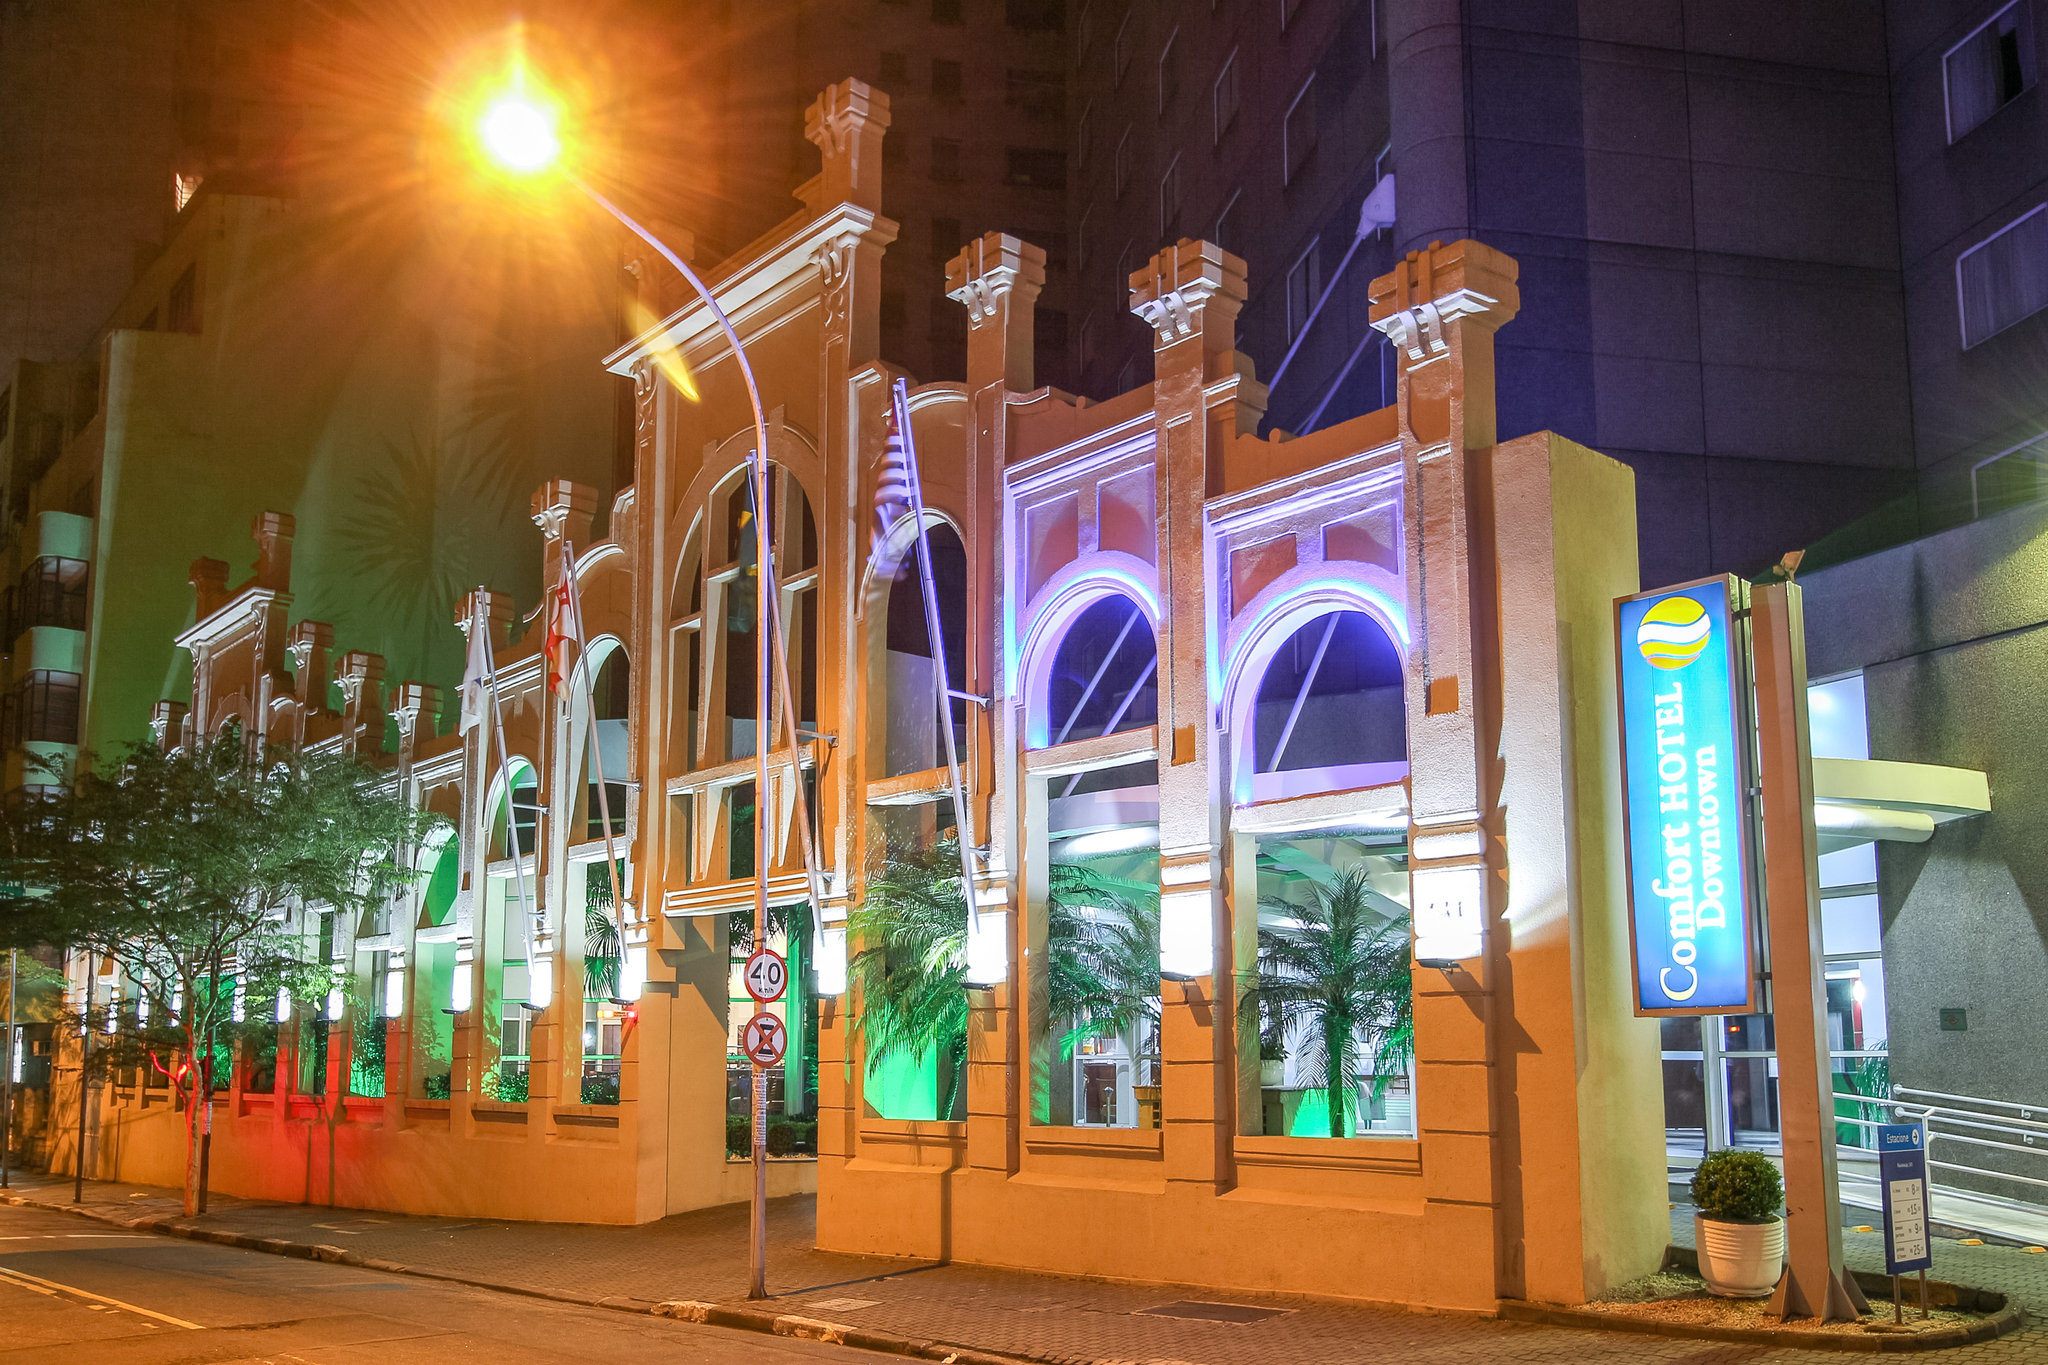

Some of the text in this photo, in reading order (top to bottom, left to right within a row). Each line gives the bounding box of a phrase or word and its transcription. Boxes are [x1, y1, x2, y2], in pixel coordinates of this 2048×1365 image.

[1651, 681, 1699, 1002] Comfort HOTEL
[1695, 744, 1726, 931] Downtown
[750, 961, 781, 985] 40
